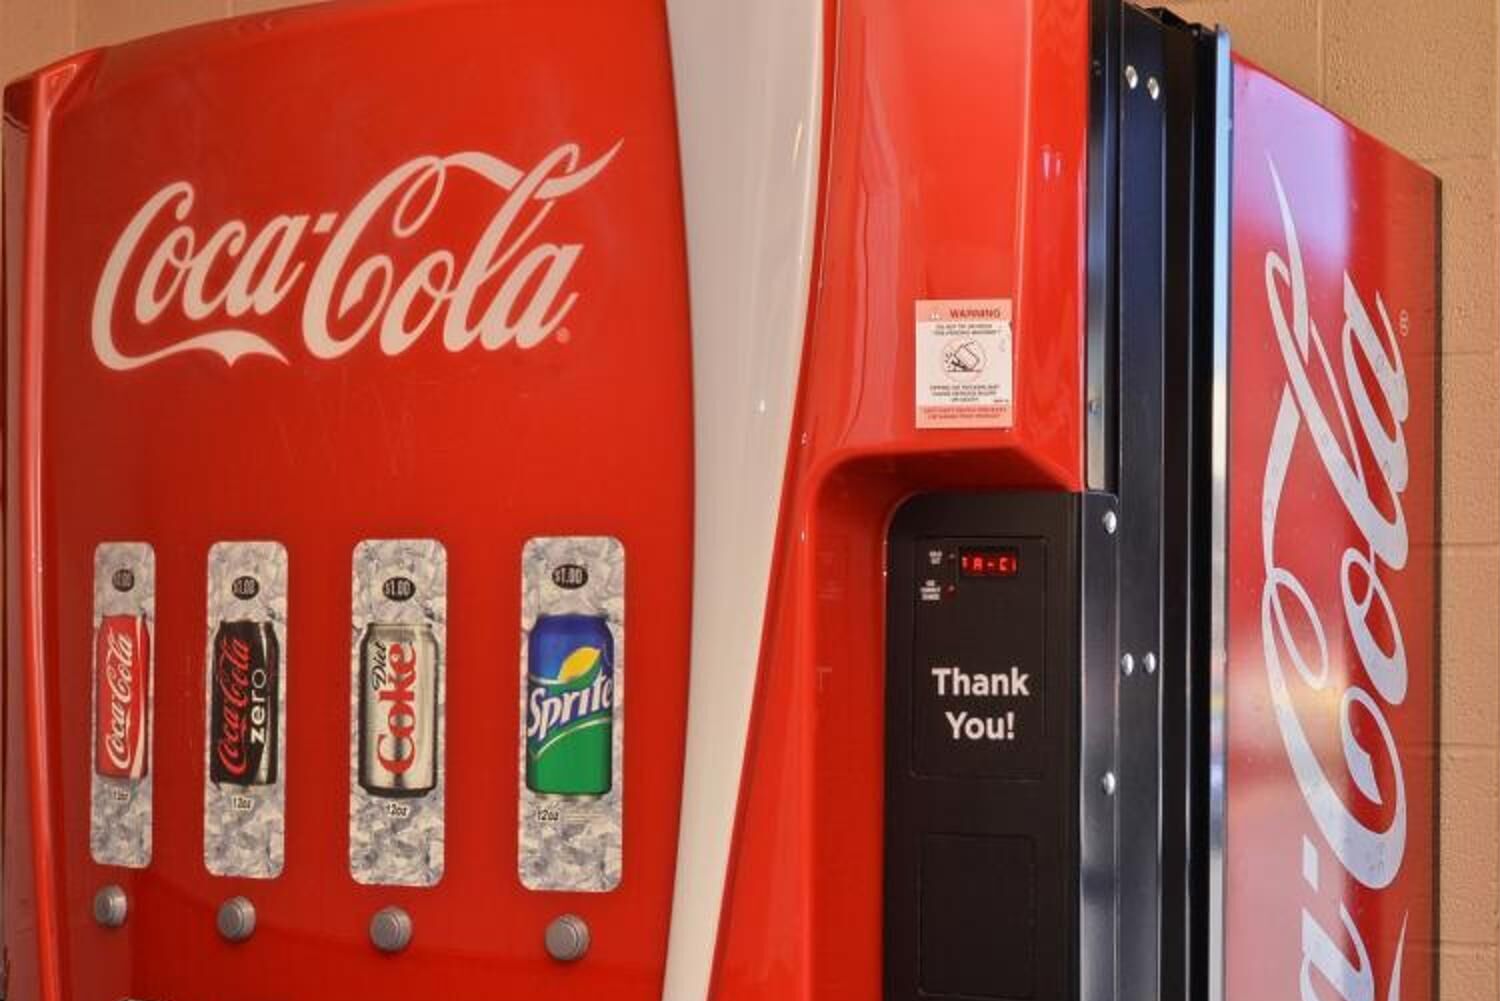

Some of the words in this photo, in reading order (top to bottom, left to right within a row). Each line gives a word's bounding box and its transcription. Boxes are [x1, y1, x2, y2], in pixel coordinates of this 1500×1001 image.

[92, 137, 625, 371] Coca-Cola
[949, 308, 1001, 319] WARNING
[384, 579, 412, 597] $1.00
[553, 569, 584, 586] $1.00
[371, 640, 388, 692] Diet
[931, 666, 1030, 696] Thank
[105, 626, 134, 769] Coca-Cola
[217, 635, 250, 775] Coca-Cola
[250, 668, 267, 744] zero
[377, 643, 417, 775] Coke
[527, 669, 613, 741] Sprite
[944, 711, 1015, 740] You!
